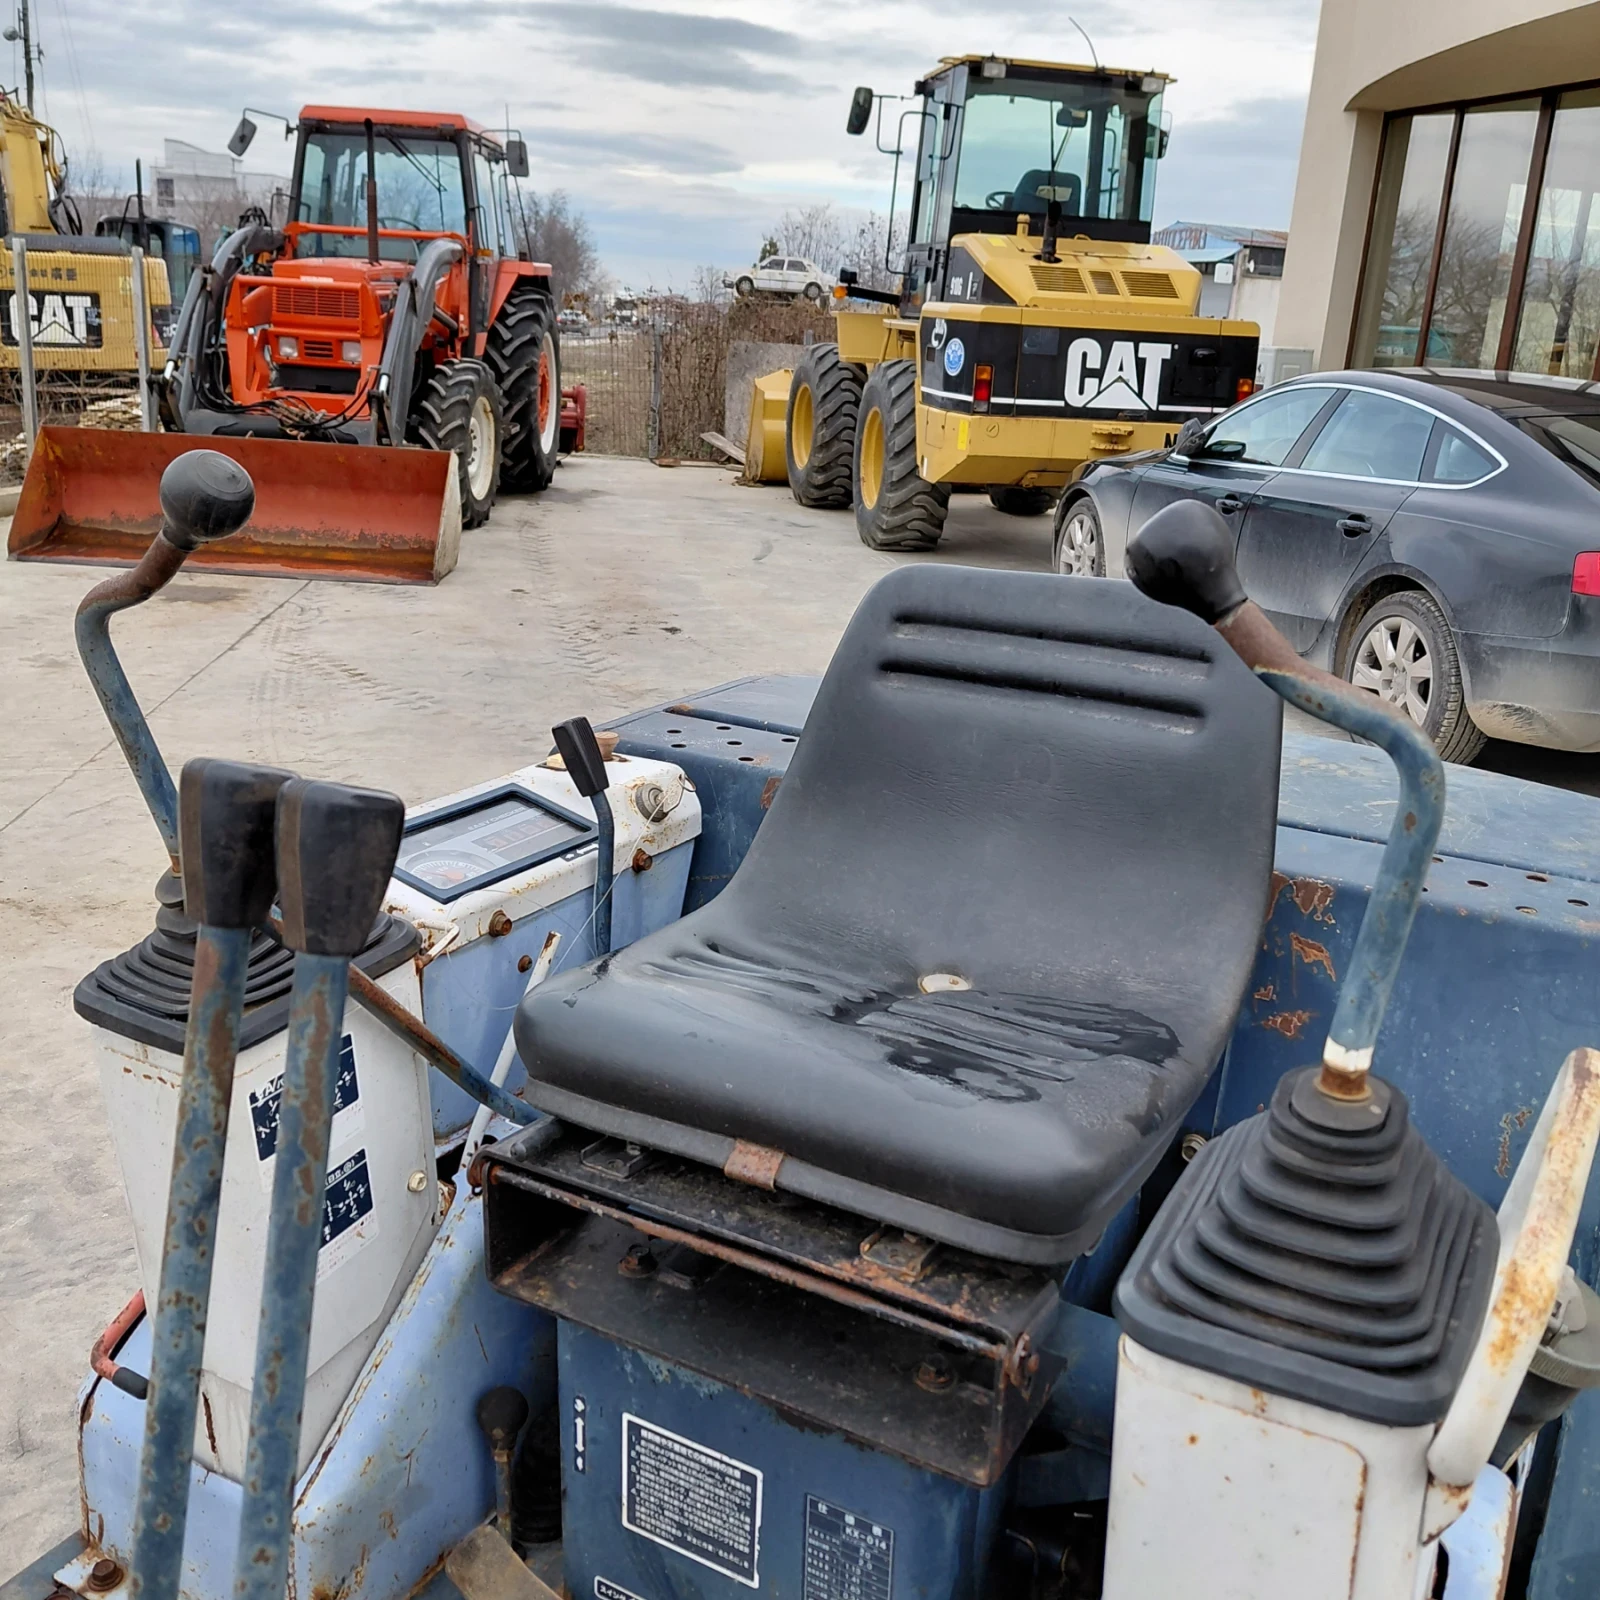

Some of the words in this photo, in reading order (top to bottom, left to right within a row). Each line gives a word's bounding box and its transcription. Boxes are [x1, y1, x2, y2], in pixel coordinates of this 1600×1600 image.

[9, 293, 92, 345] CAT
[1064, 337, 1172, 411] CAT
[467, 819, 490, 831] EASY
[490, 806, 527, 822] CHECKER
[845, 1526, 887, 1550] KX-014
